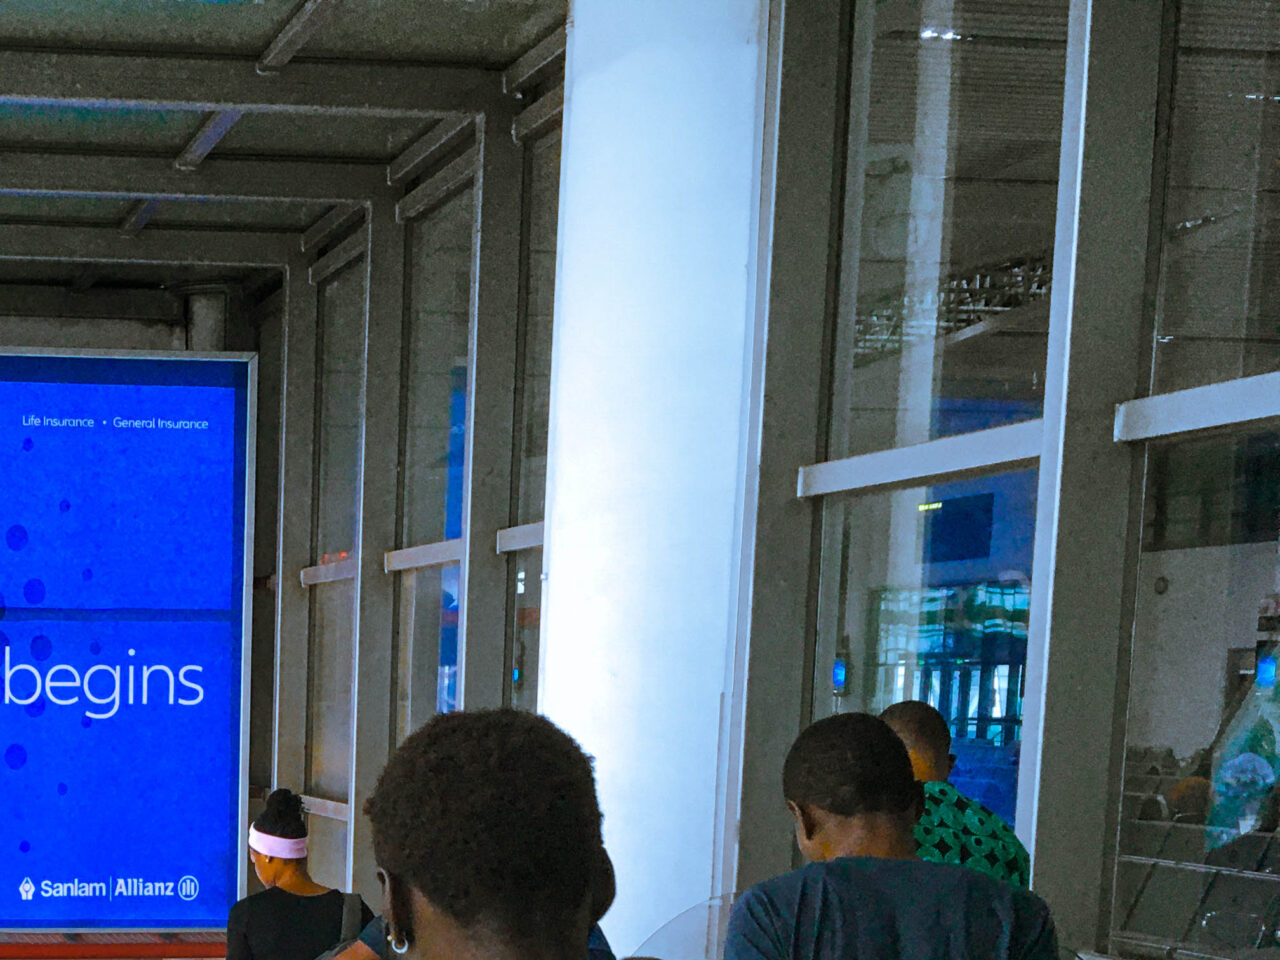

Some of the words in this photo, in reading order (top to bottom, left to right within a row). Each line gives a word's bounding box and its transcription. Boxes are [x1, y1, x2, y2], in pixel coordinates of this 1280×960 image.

[22, 415, 41, 427] Life
[43, 415, 95, 428] Insurance
[113, 416, 156, 429] General
[158, 417, 209, 430] Insurance
[4, 646, 204, 719] begins
[40, 878, 106, 897] Sanlam
[114, 877, 174, 897] Allianz
